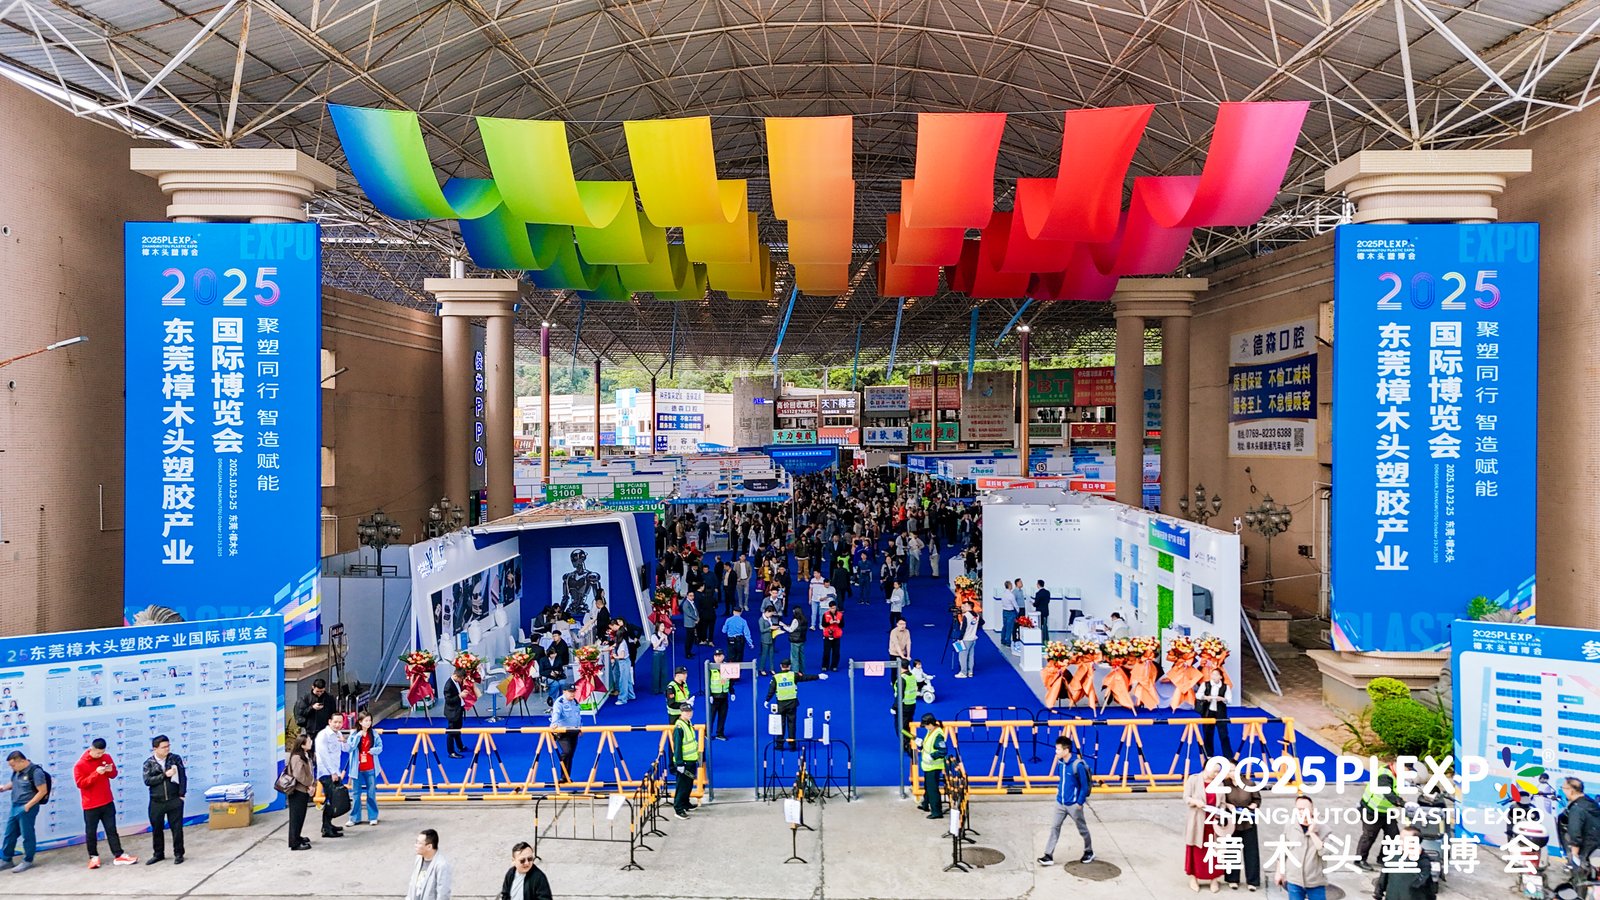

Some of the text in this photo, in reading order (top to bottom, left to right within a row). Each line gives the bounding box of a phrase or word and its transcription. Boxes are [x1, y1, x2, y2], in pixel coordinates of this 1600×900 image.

[240, 225, 313, 261] EXPO
[1459, 226, 1535, 263] EXPO
[161, 267, 281, 307] 2025
[1376, 270, 1501, 310] 2025
[1253, 326, 1305, 356] 德森口腔
[211, 317, 244, 454] 国际博览会
[1233, 371, 1263, 392] 质量保证
[1428, 321, 1464, 459] 国际博览会
[257, 317, 280, 491] 聚塑同行 智造赋能
[1233, 395, 1263, 415] 服务至上
[1474, 321, 1500, 497] 聚塑同行 智造赋能
[162, 317, 195, 564] 东莞樟木头塑胶产业
[1375, 321, 1412, 571] 东莞樟木头塑胶产业
[552, 489, 576, 497] 3100
